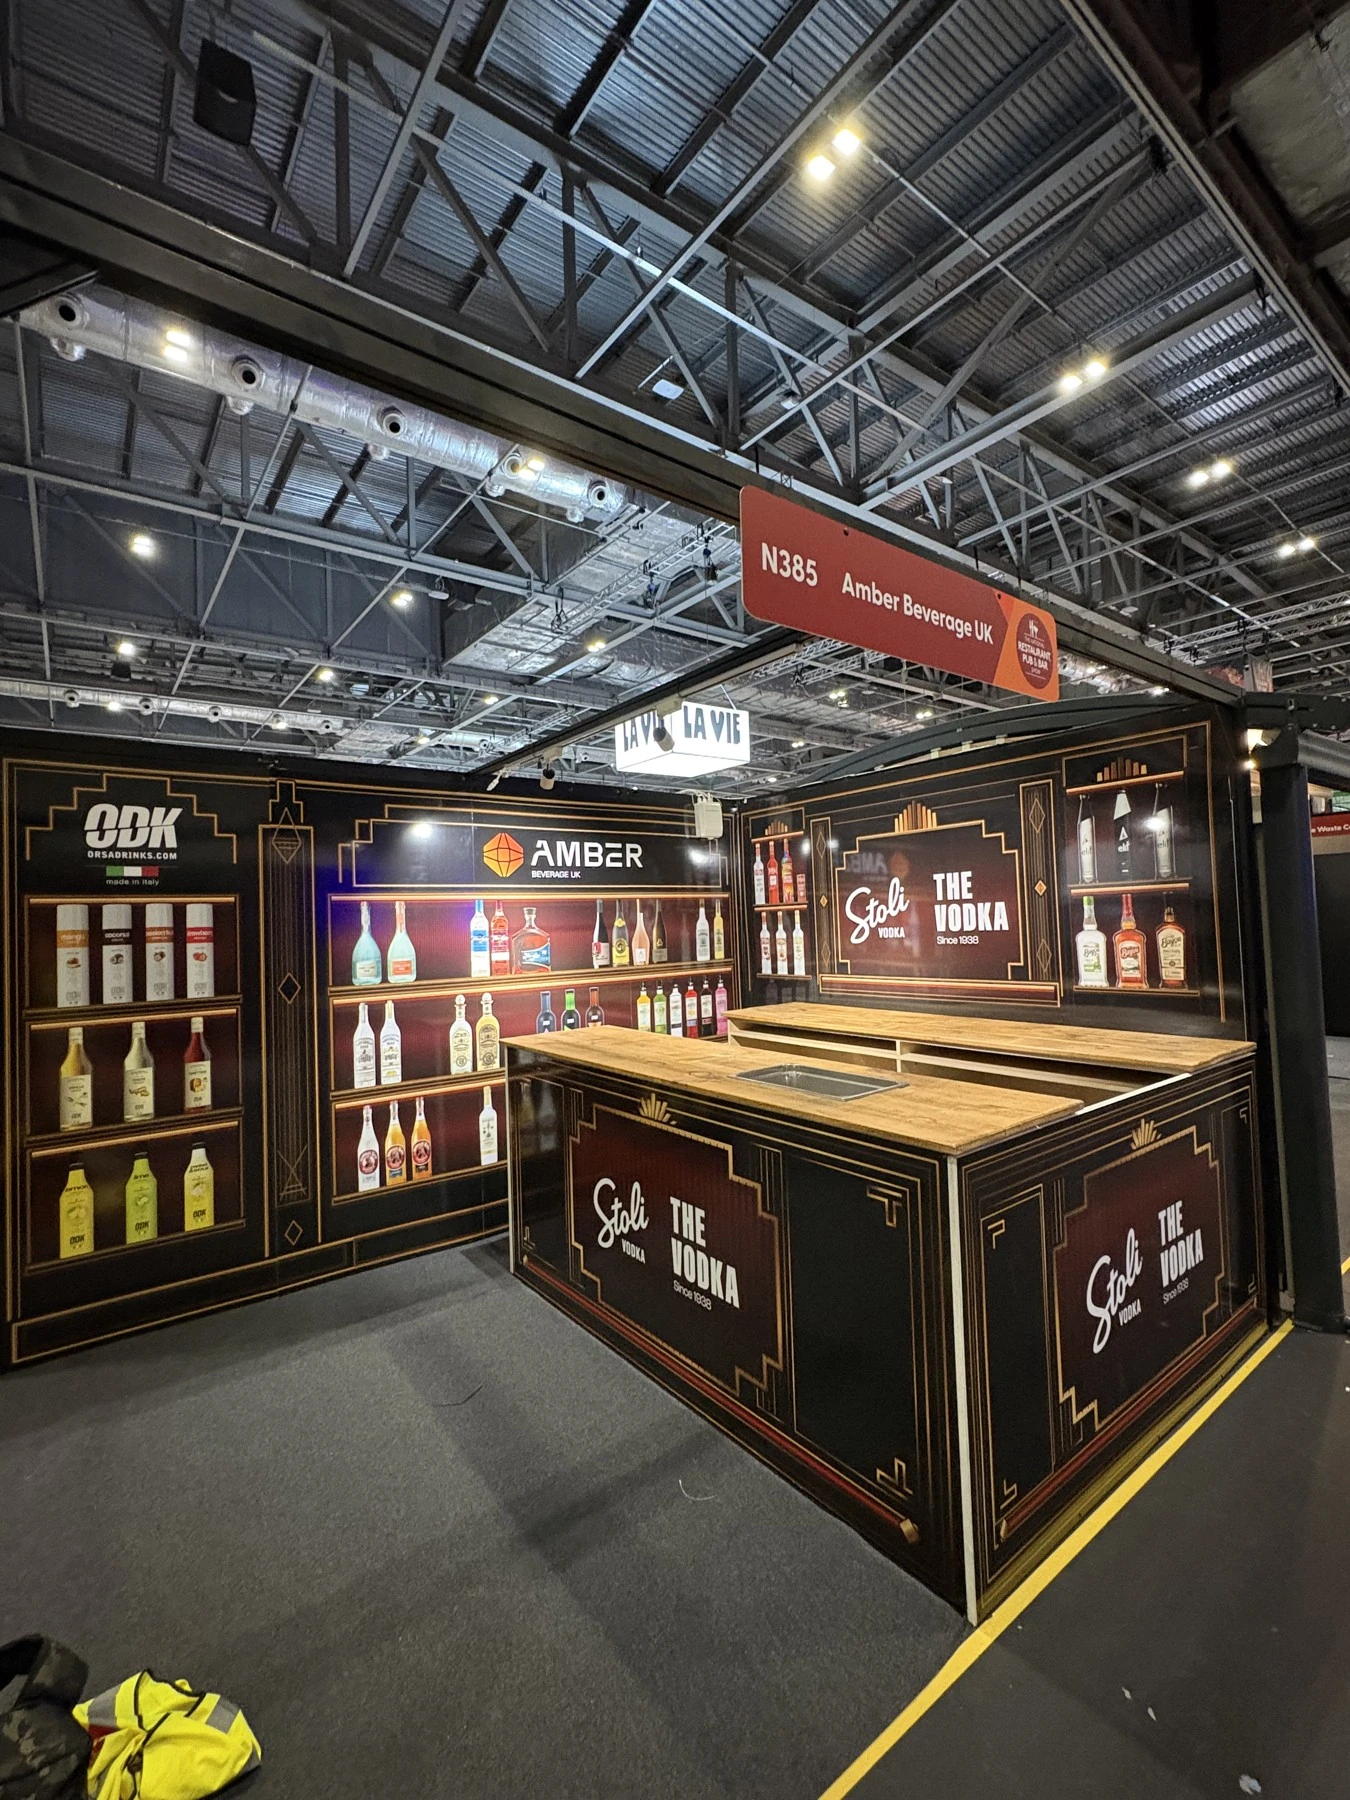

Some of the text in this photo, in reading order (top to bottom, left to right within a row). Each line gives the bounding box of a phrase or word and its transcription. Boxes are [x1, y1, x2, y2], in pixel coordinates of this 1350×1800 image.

[761, 542, 818, 587] N385
[842, 572, 994, 645] Amber Beverage UK
[1018, 640, 1051, 661] RESTAURANT
[1022, 653, 1033, 666] PUB
[1037, 659, 1048, 671] BAR
[684, 705, 740, 745] LA VIE
[84, 803, 183, 849] ODK
[1317, 825, 1342, 833] Waste
[87, 850, 178, 860] ORSADRINKS.COM
[531, 839, 644, 869] AMBER
[142, 878, 160, 887] italy
[531, 870, 581, 879] BEVERAGE UK
[933, 871, 973, 901] THE
[845, 876, 910, 944] Stoli
[934, 901, 1009, 932] VODKA
[878, 927, 905, 939] VODKA
[937, 935, 979, 945] Since 1938
[593, 1177, 649, 1249] Stoli
[669, 1196, 706, 1248] THE
[1158, 1200, 1184, 1247] THE
[69, 1233, 85, 1244] ODK
[621, 1238, 646, 1264] VODKA
[671, 1236, 740, 1309] VODKA
[1159, 1228, 1204, 1288] VODKA
[673, 1279, 712, 1311] Since 1938
[1086, 1228, 1143, 1354] Stoli
[1163, 1287, 1177, 1305] Since
[1118, 1298, 1142, 1327] VODKA
